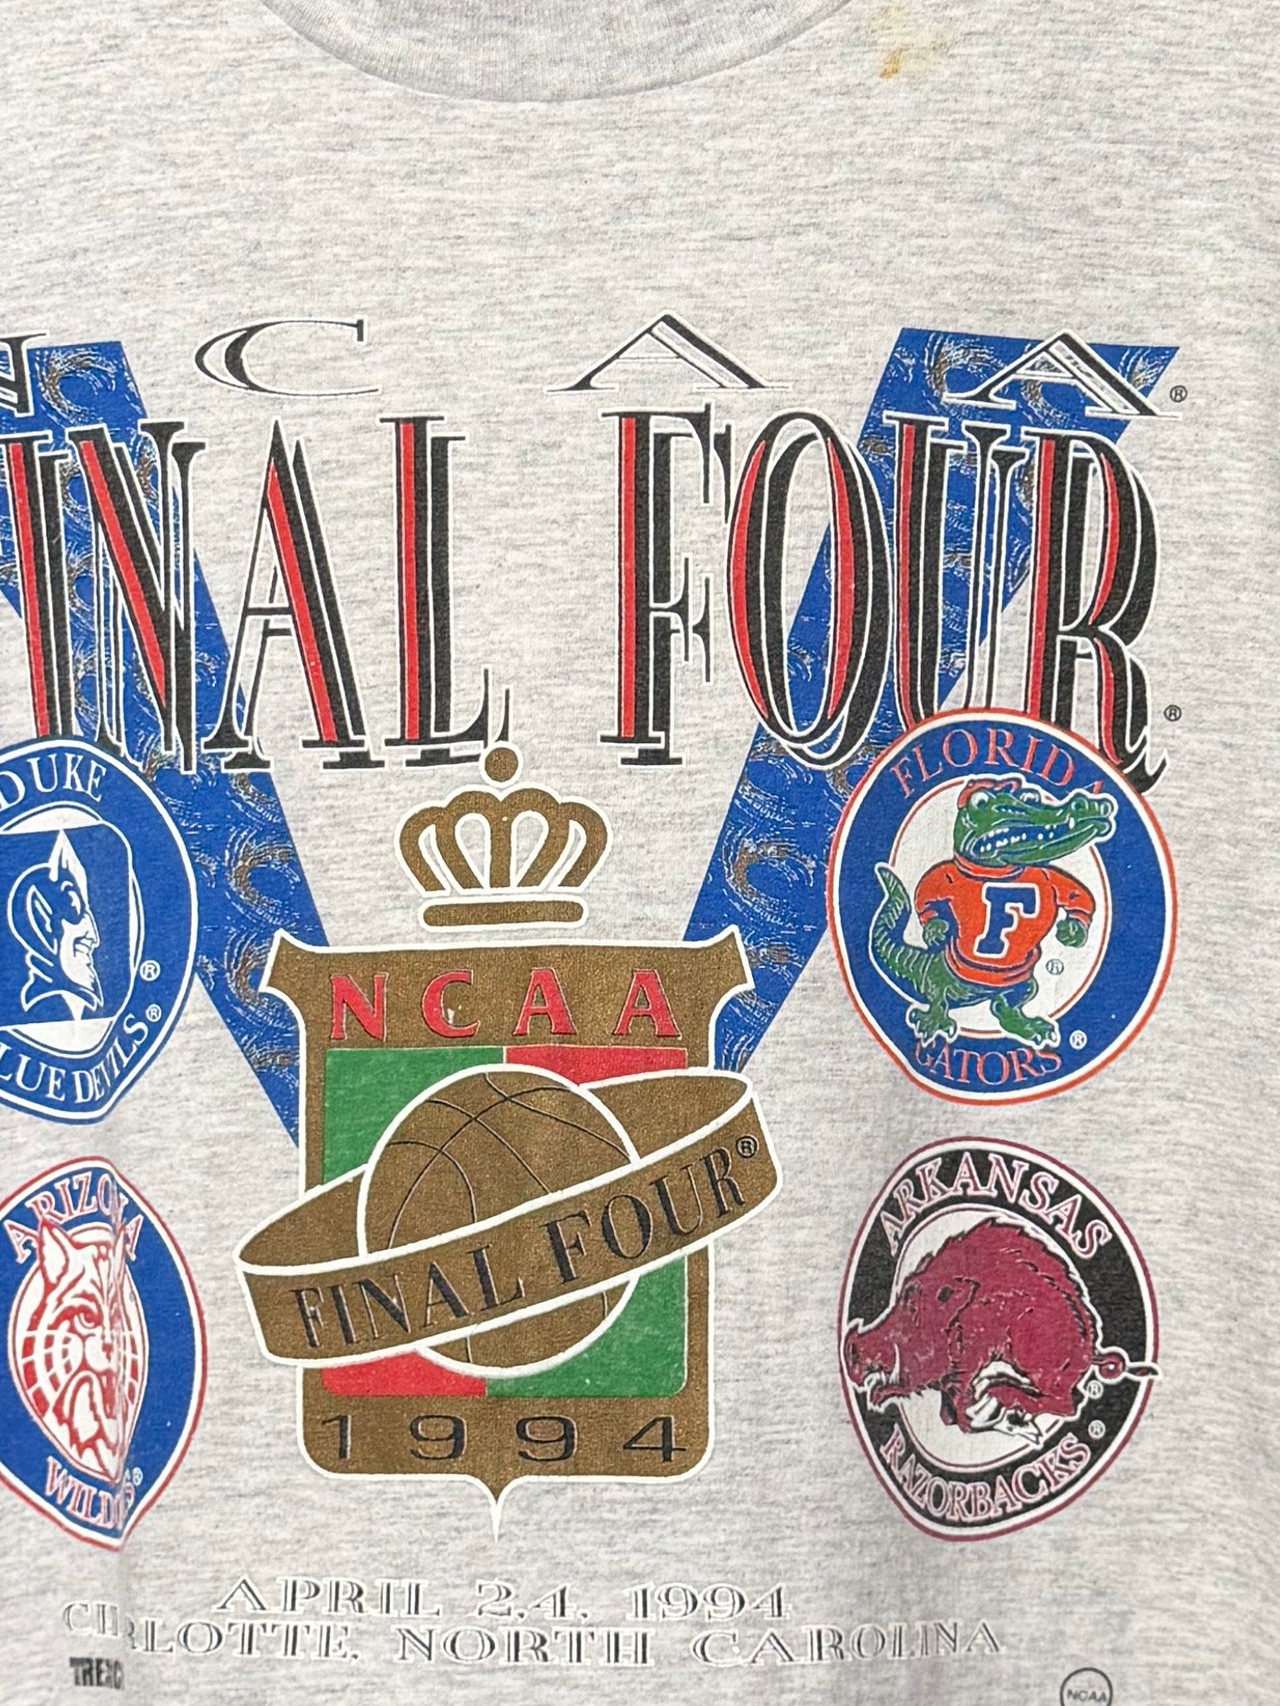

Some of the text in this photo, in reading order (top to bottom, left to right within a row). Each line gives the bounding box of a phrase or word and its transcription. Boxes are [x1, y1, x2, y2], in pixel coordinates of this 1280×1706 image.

[599, 400, 1169, 796] FOUR
[328, 967, 681, 1041] NCAA
[72, 1012, 151, 1105] DEVILS
[914, 1041, 1063, 1087] GATORS
[3, 1171, 144, 1265] ARIZOA
[291, 1145, 746, 1350] FINAL FOUR
[879, 1151, 1113, 1259] ARKANSAS
[320, 1413, 687, 1462] 1994
[879, 1423, 1092, 1523] RAZORBACKS
[214, 1572, 443, 1618] APRIL
[623, 1580, 793, 1621] 1994
[393, 1625, 656, 1667] NORTH
[689, 1617, 1005, 1667] CAROLINA
